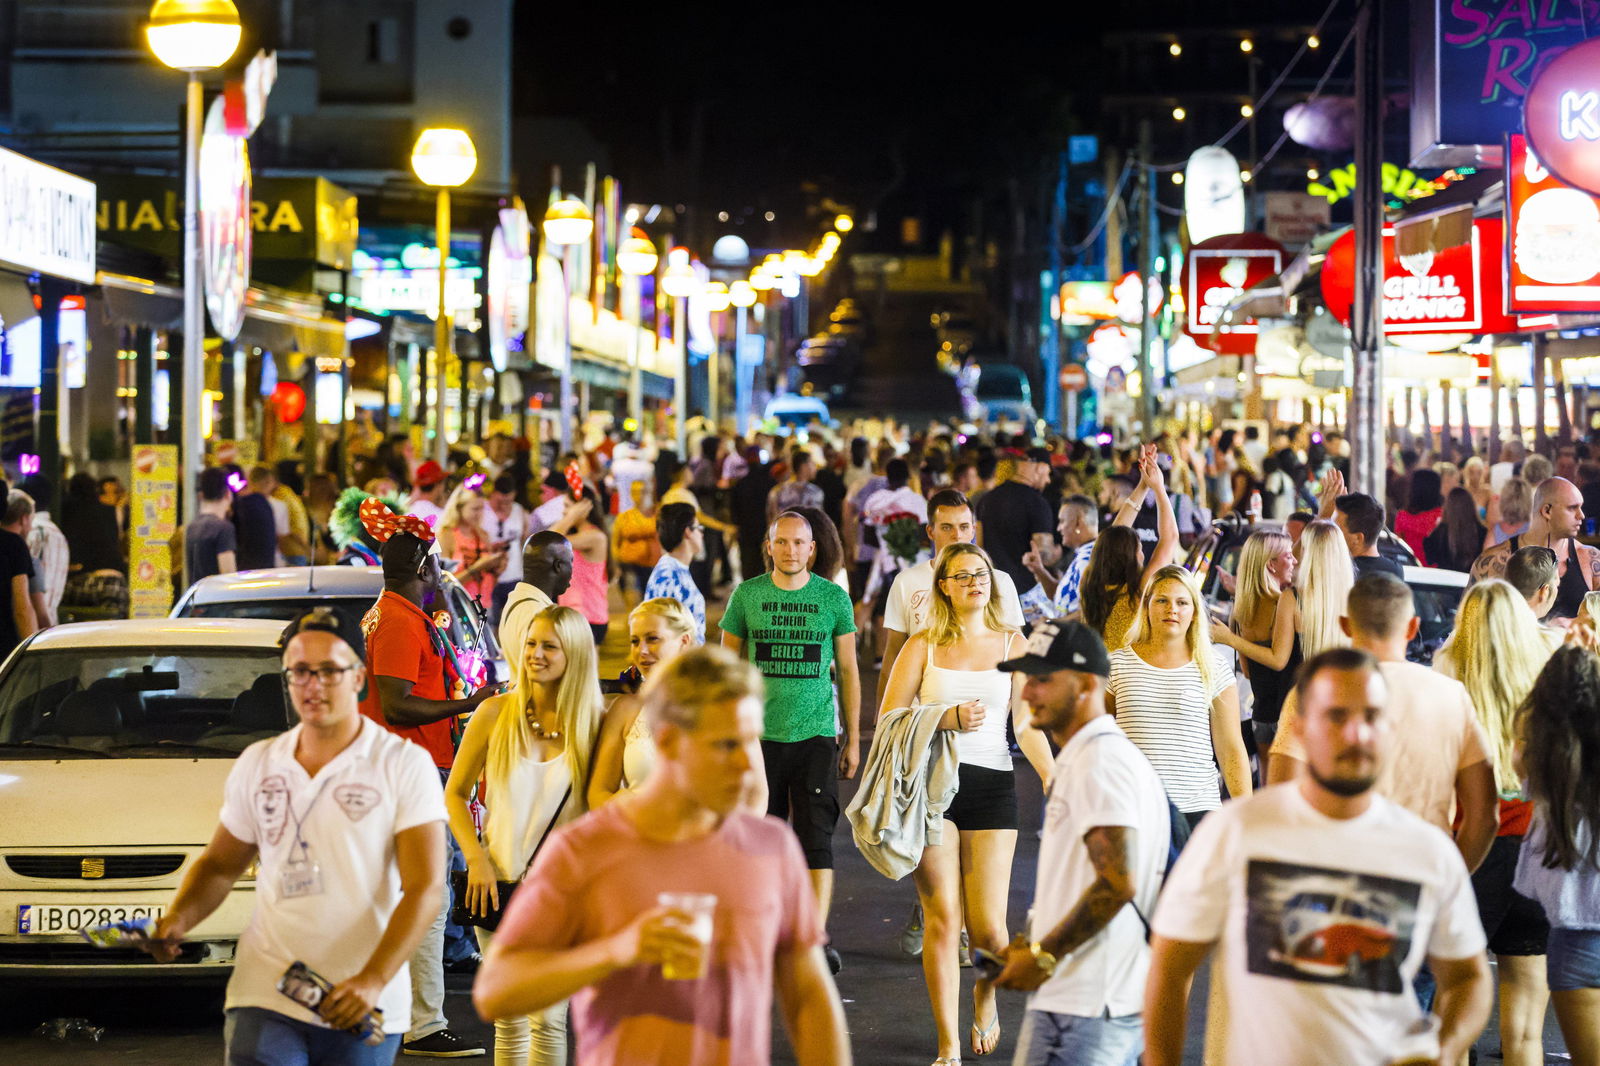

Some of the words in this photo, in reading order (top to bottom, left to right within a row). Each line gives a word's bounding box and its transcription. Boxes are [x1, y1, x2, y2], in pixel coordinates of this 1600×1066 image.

[1383, 275, 1460, 297] GRILL
[762, 602, 778, 612] WER
[781, 602, 819, 614] MONTAGS
[771, 645, 804, 659] GEILES
